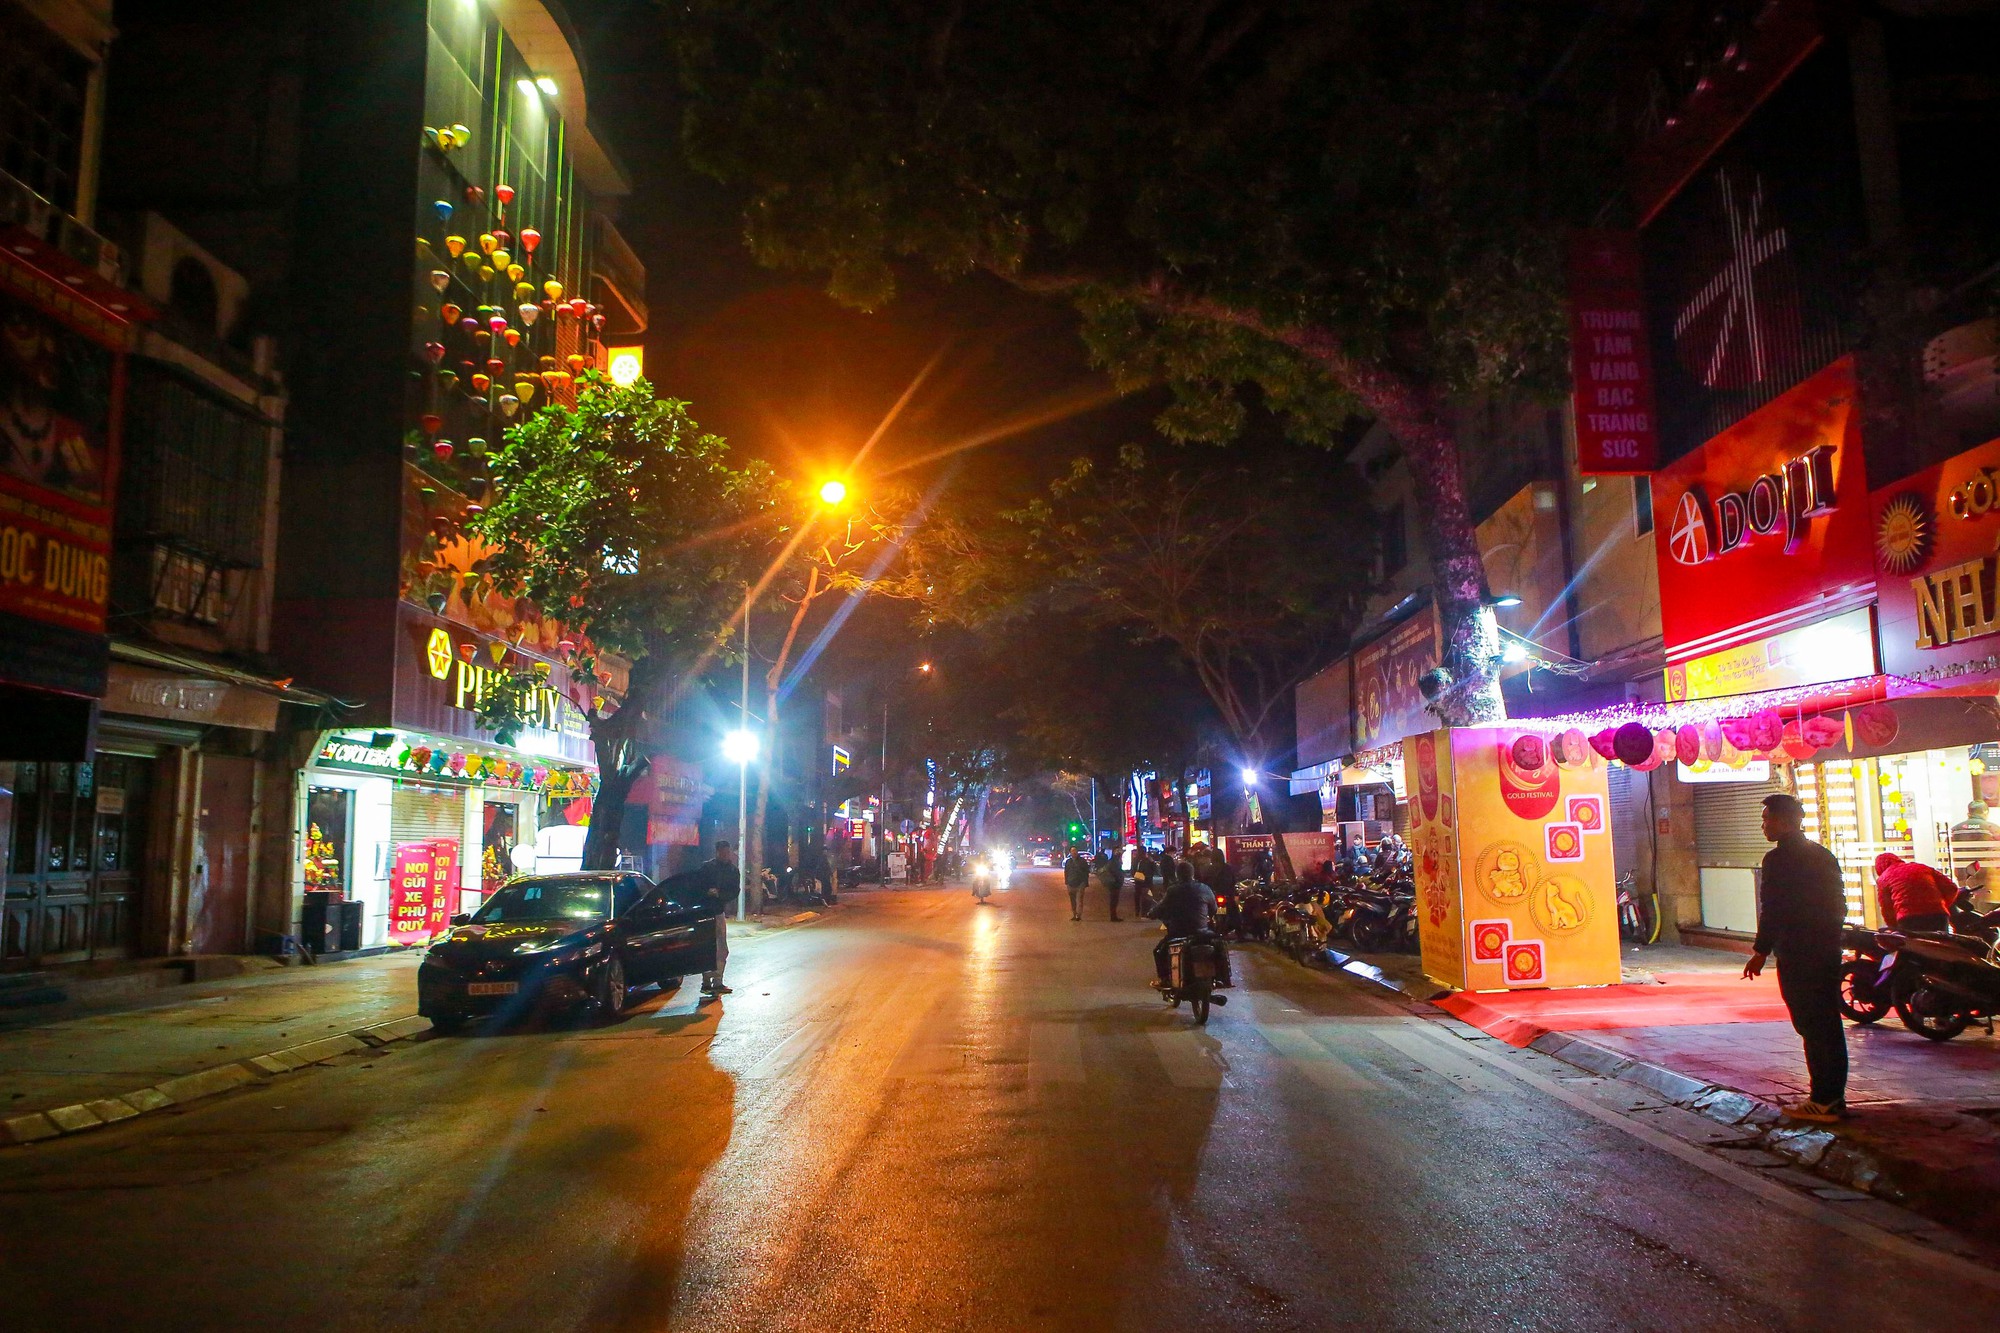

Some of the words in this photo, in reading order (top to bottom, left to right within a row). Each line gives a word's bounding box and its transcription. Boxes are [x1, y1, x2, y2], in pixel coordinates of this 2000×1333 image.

[1580, 312, 1641, 329] TRUNG
[1597, 387, 1635, 410] BẠC
[1588, 414, 1648, 432] TRANG
[1602, 437, 1640, 459] SỨC
[1715, 446, 1831, 555] DOJI
[0, 526, 36, 586] ỌC
[44, 540, 108, 604] DUNG
[1910, 547, 2000, 650] NH
[1527, 791, 1554, 799] FESTIVAL
[404, 862, 429, 874] NƠI
[433, 868, 447, 880] ỬI
[402, 874, 427, 888] GỬI
[434, 884, 443, 895] E
[404, 891, 423, 903] XE
[398, 904, 427, 917] PHÚ
[397, 918, 426, 932] QUÝ
